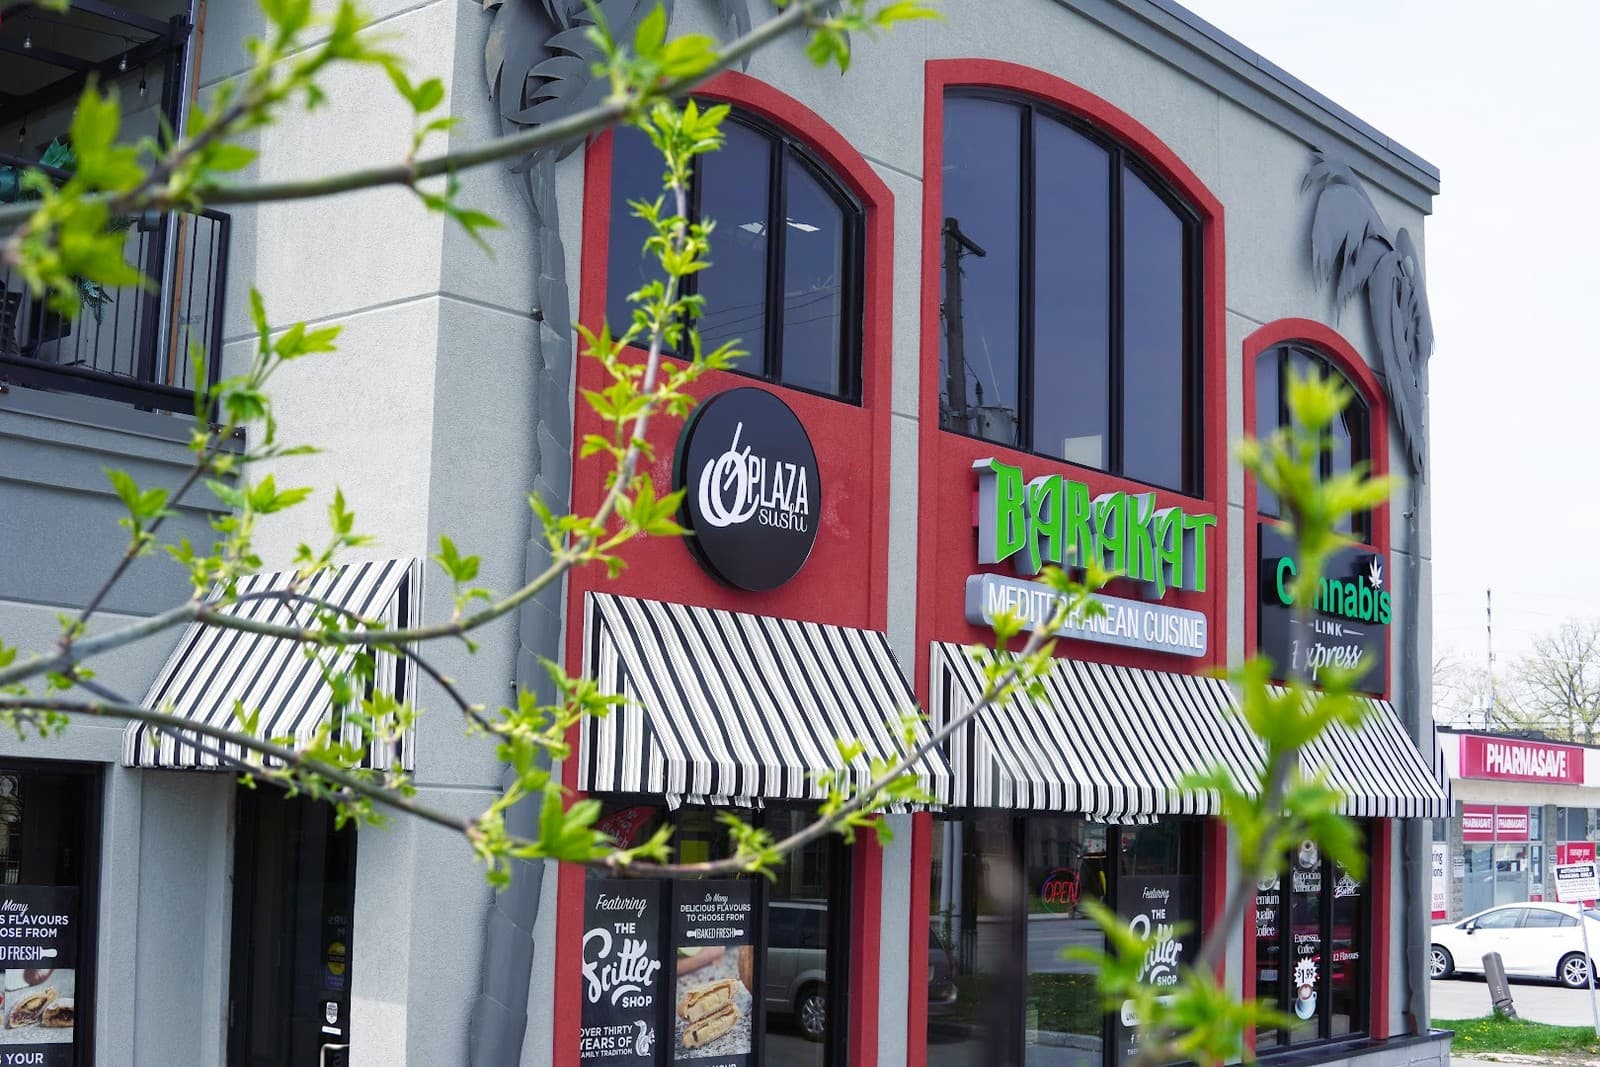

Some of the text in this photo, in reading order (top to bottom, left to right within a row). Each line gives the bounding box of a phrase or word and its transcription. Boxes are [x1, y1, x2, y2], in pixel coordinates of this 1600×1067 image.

[747, 454, 809, 515] PLAZA
[758, 503, 808, 533] sushi
[982, 457, 1217, 600] BARAKAT
[1276, 556, 1392, 625] Cnnabis
[1143, 611, 1204, 650] CUISINE
[1315, 619, 1342, 637] LINK
[1486, 743, 1567, 778] PHARMASAVE
[1498, 818, 1525, 829] PHARMASAVE
[1045, 881, 1078, 904] OPEN
[1143, 886, 1170, 905] Featuring
[1, 899, 29, 917] Many
[595, 894, 647, 918] Featuring
[680, 903, 751, 913] DELICIOUS FLAVOURS
[8, 914, 69, 925] FLAVOURS
[686, 913, 745, 922] TO CHOOSE FROM
[1151, 909, 1166, 920] THE
[25, 927, 57, 938] FROM
[614, 922, 636, 934] THE
[8, 946, 39, 961] FRESH
[1156, 975, 1178, 986] SHOP
[622, 995, 652, 1008] SHOP
[603, 1024, 633, 1036] THIRTY
[617, 1036, 633, 1048] OF
[5, 1052, 44, 1065] YOUR
[580, 1048, 633, 1059] AMILY TRADITION
